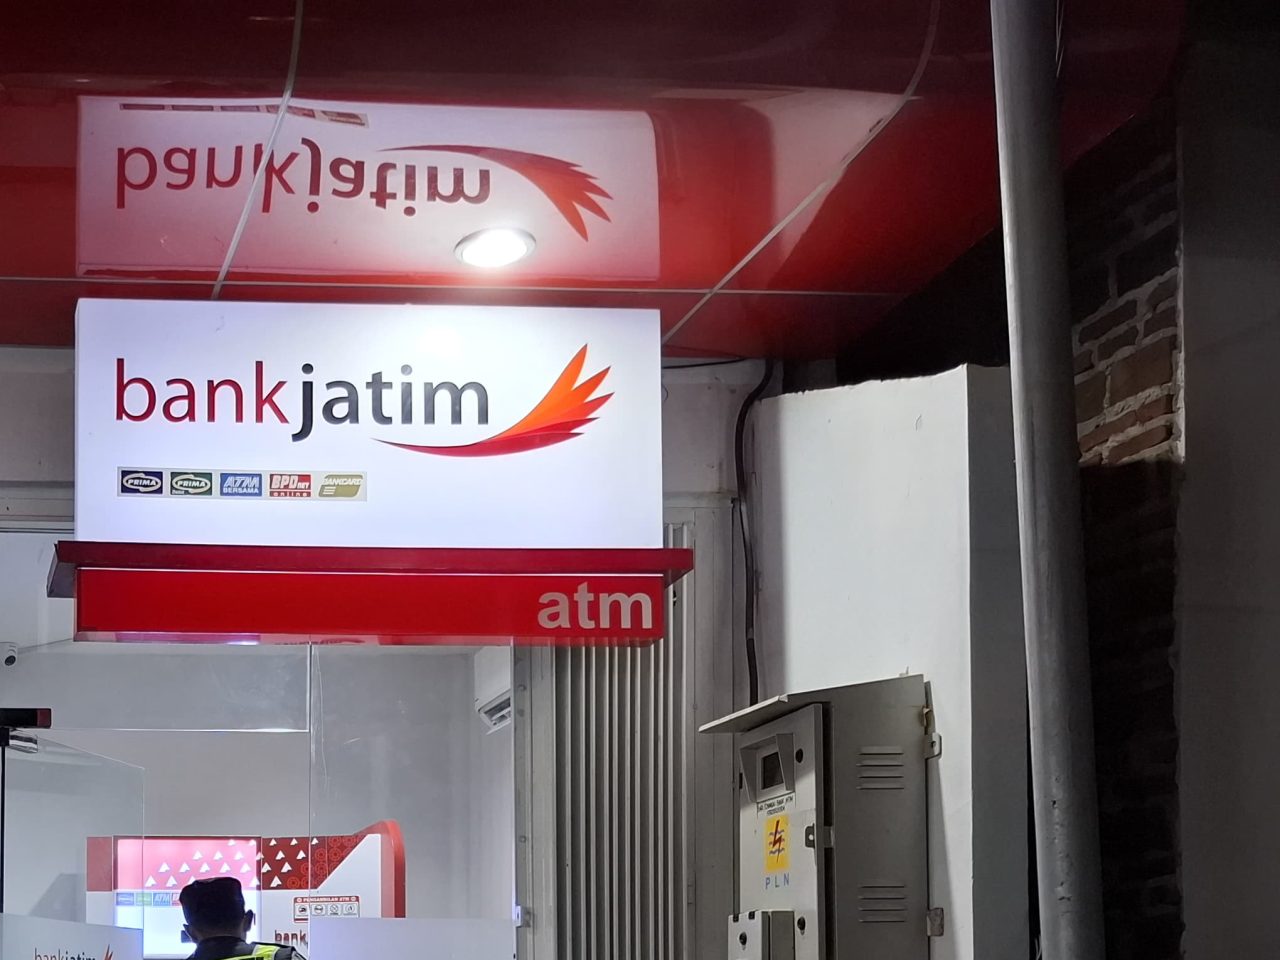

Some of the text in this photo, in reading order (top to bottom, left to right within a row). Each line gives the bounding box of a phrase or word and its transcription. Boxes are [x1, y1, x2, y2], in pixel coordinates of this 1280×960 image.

[115, 357, 490, 443] bankjatim
[127, 479, 156, 487] PRIMA
[177, 480, 206, 488] PRIMA
[223, 476, 260, 488] ATM
[537, 582, 653, 630] atm
